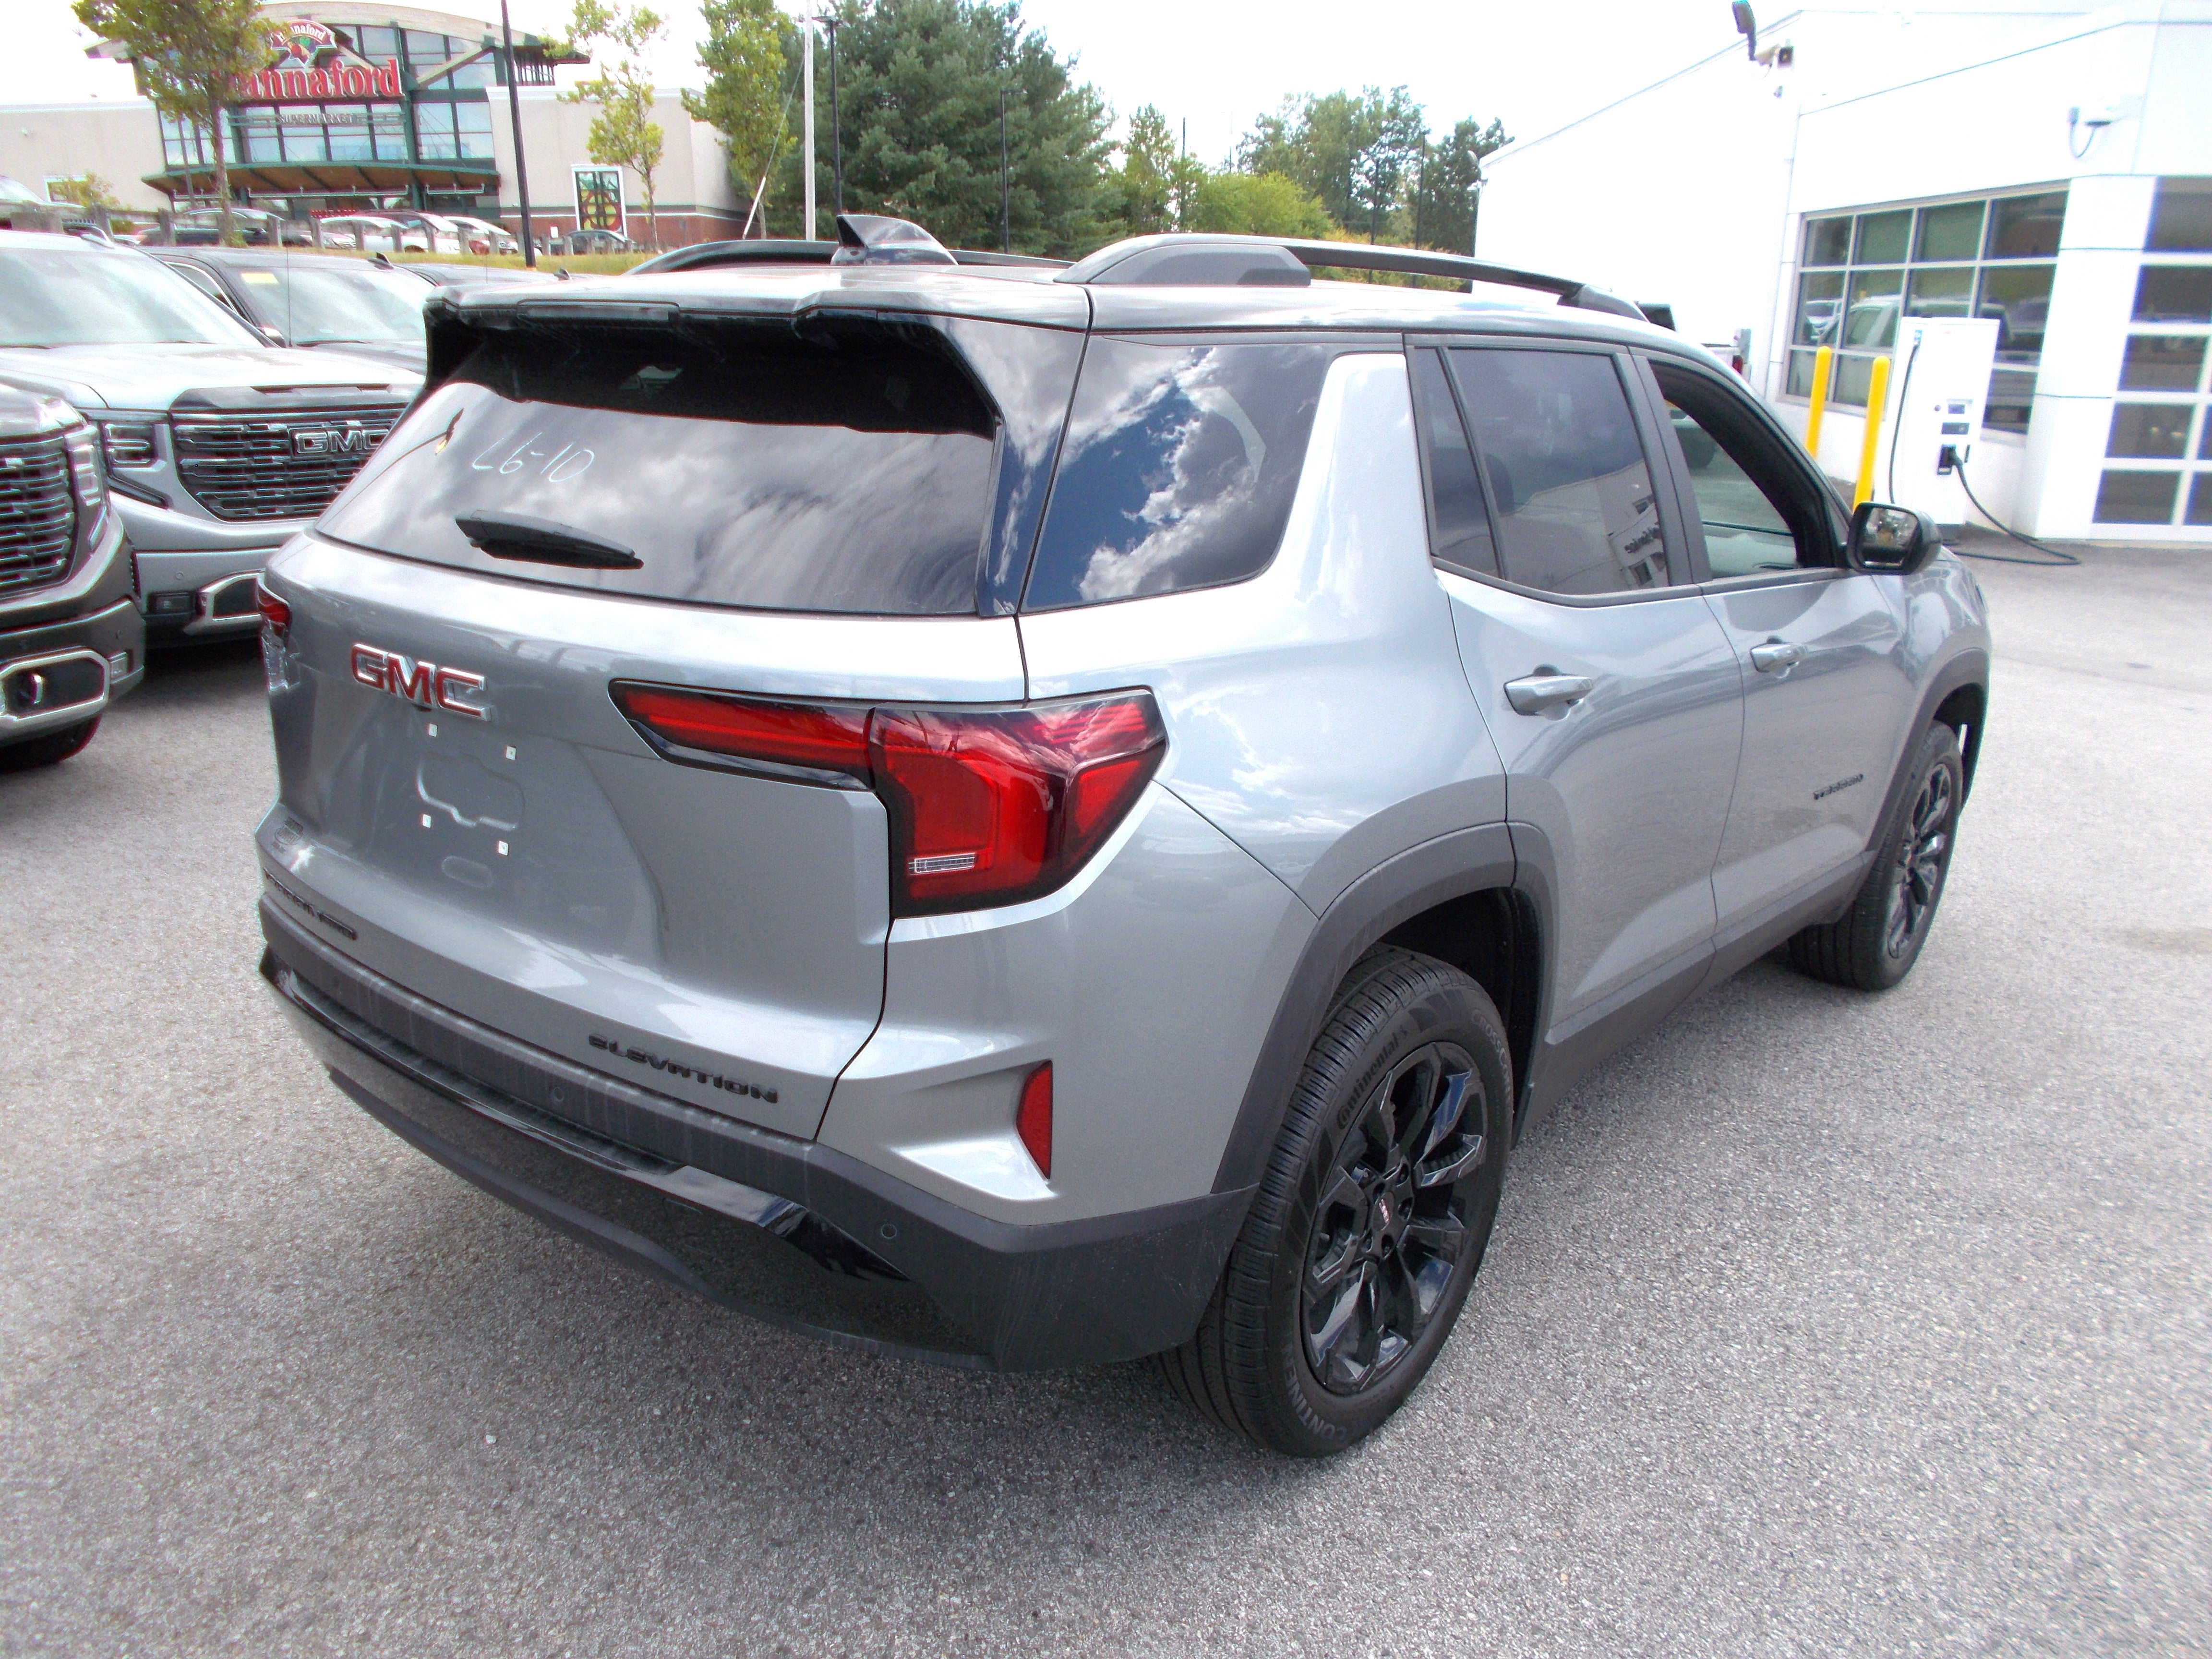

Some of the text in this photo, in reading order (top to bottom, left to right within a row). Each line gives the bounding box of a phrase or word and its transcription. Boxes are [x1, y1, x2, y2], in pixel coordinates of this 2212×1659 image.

[229, 56, 405, 99] annaford
[276, 113, 354, 124] SUPERMARKET
[295, 429, 391, 454] GMC
[351, 643, 492, 721] GMC
[588, 1033, 778, 1104] ELEVATION
[1336, 1033, 1399, 1130] Continental
